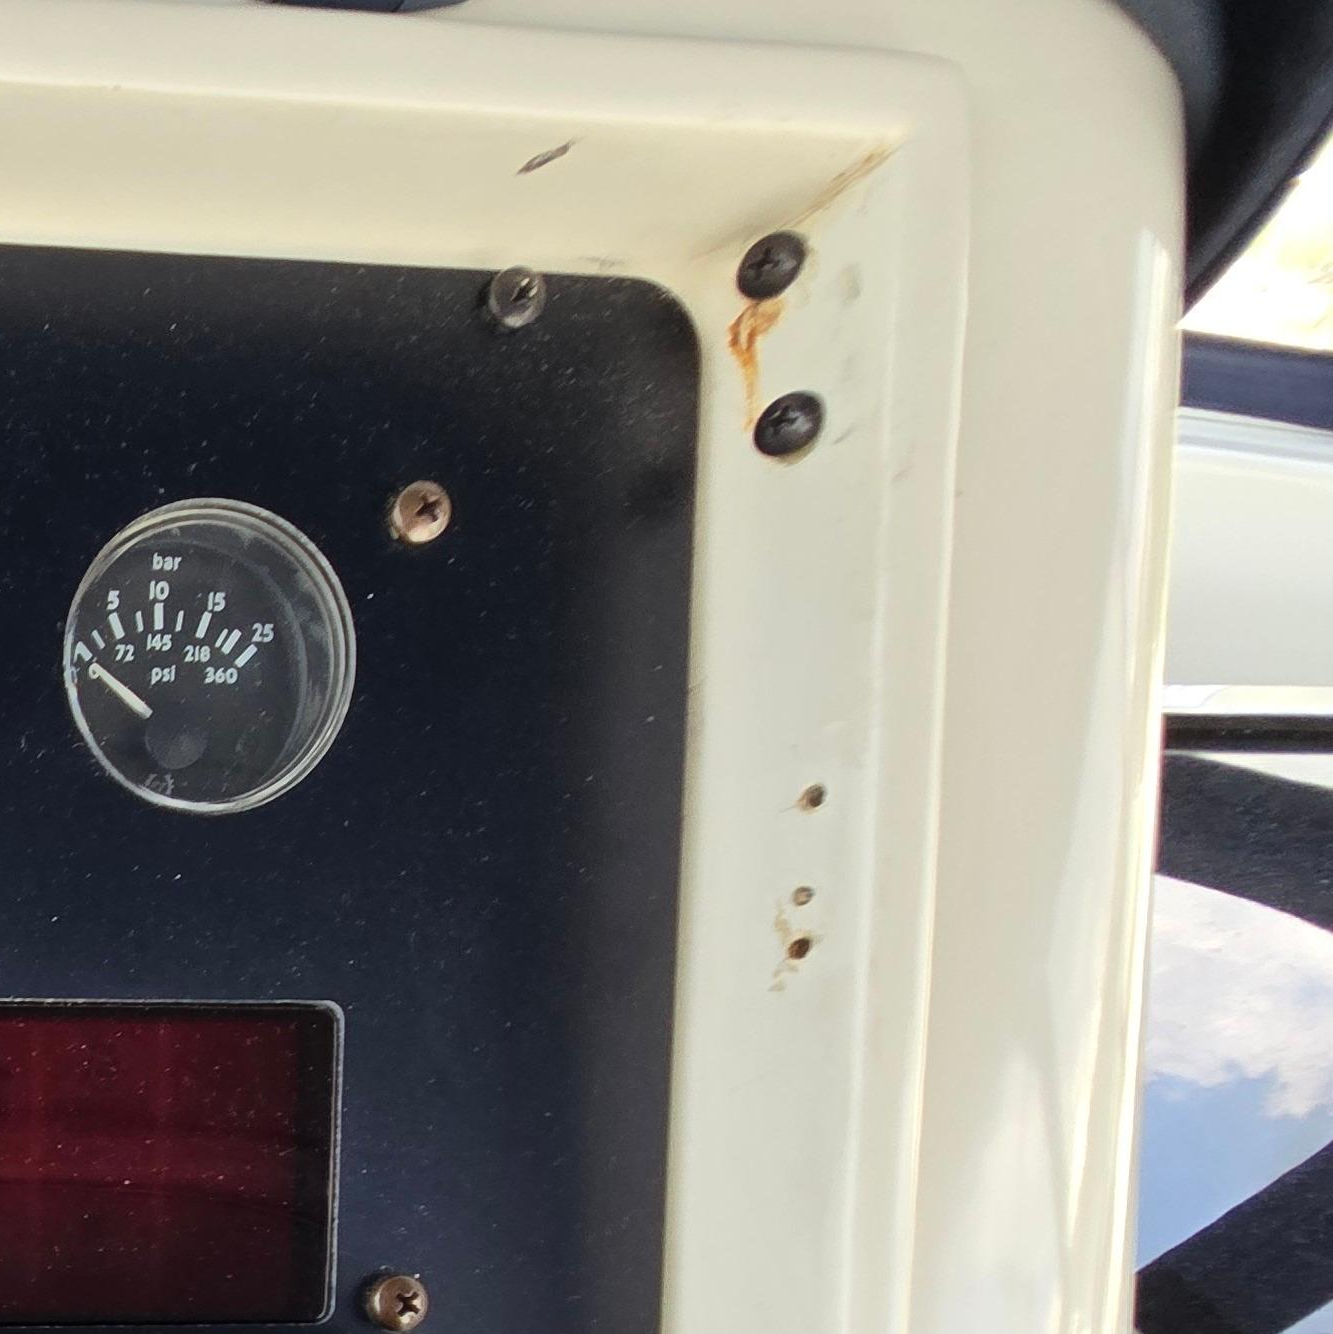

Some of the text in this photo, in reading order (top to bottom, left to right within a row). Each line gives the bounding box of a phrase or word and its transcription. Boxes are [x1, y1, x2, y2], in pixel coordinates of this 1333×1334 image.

[152, 552, 182, 571] bar
[106, 580, 275, 643] 5 10 15 25
[115, 644, 135, 662] 72
[146, 633, 173, 651] 145
[183, 645, 211, 663] 218
[203, 667, 238, 685] 360
[150, 665, 176, 685] psi
